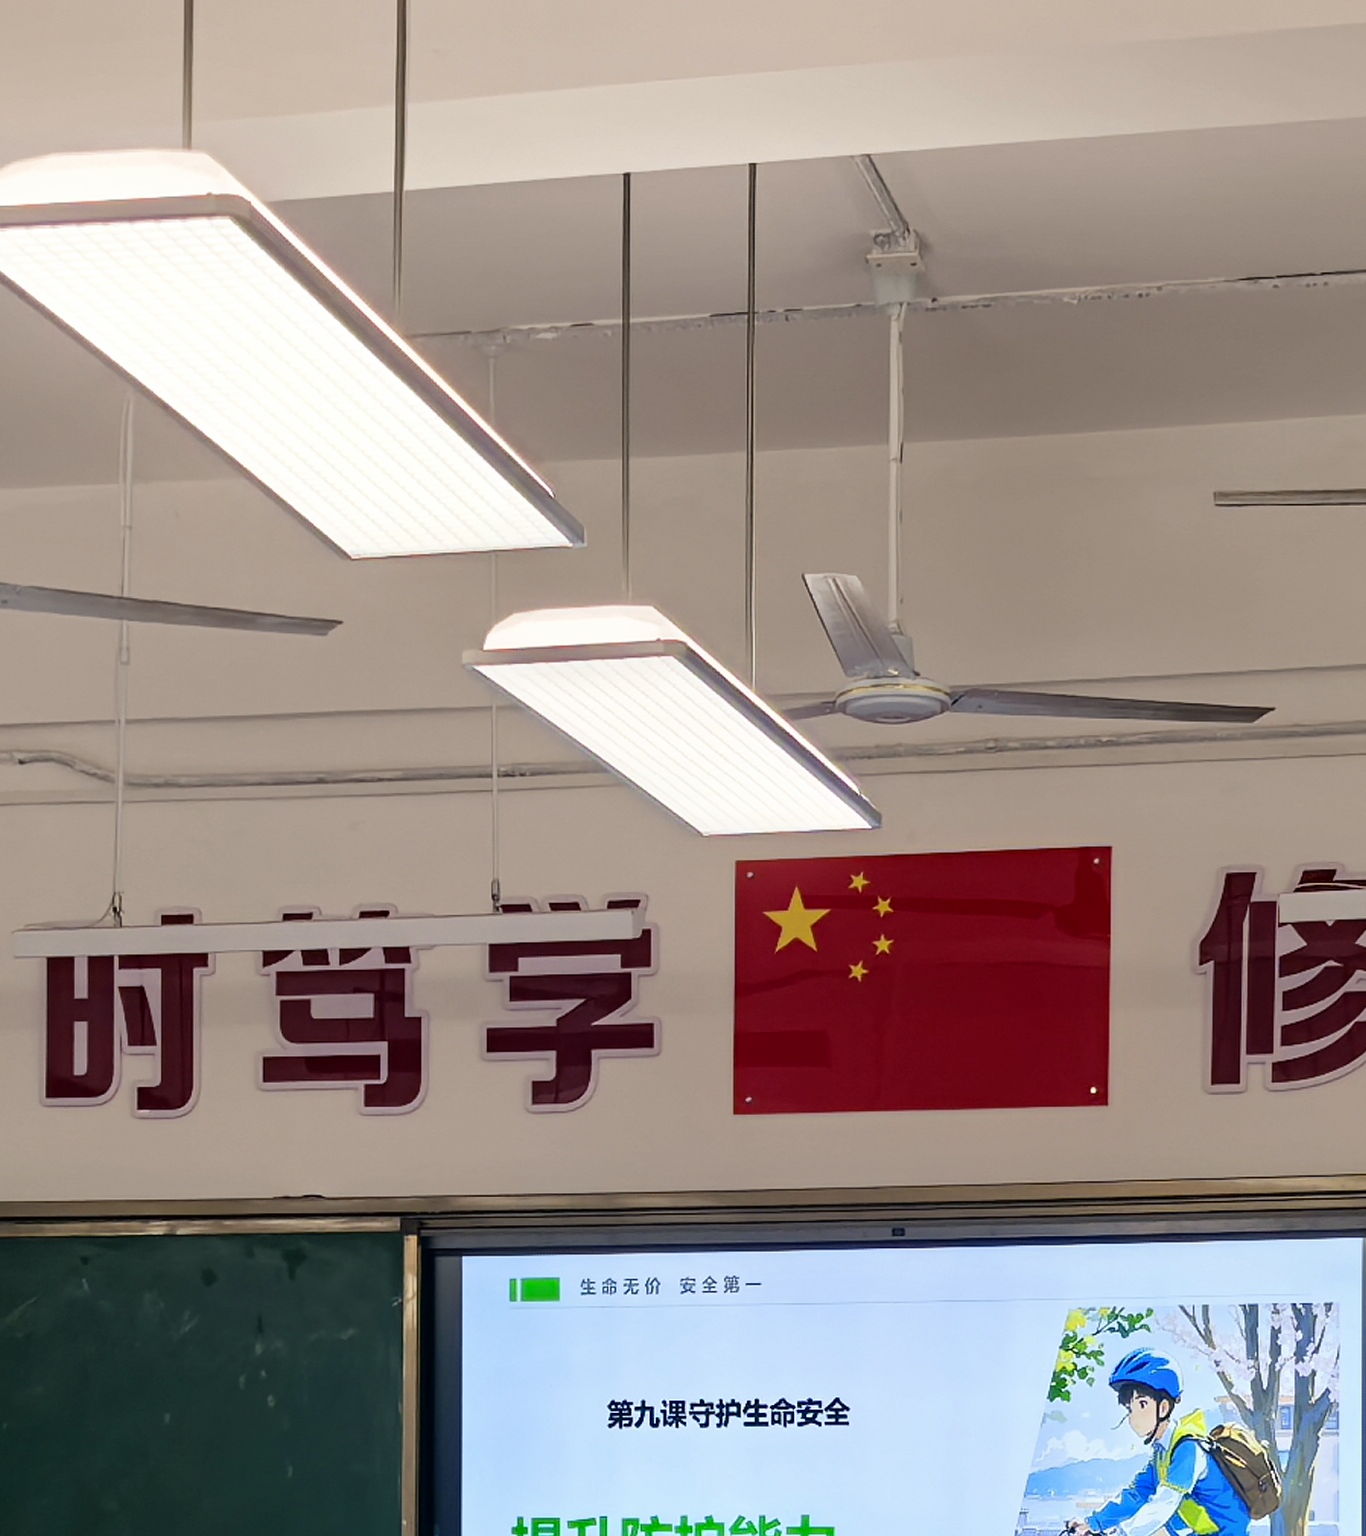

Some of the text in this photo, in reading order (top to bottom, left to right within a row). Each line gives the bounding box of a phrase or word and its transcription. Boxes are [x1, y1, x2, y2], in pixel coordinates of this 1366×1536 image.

[580, 1275, 763, 1296] 生命无价 安全第一
[606, 1397, 851, 1430] 第九课守护生命安全
